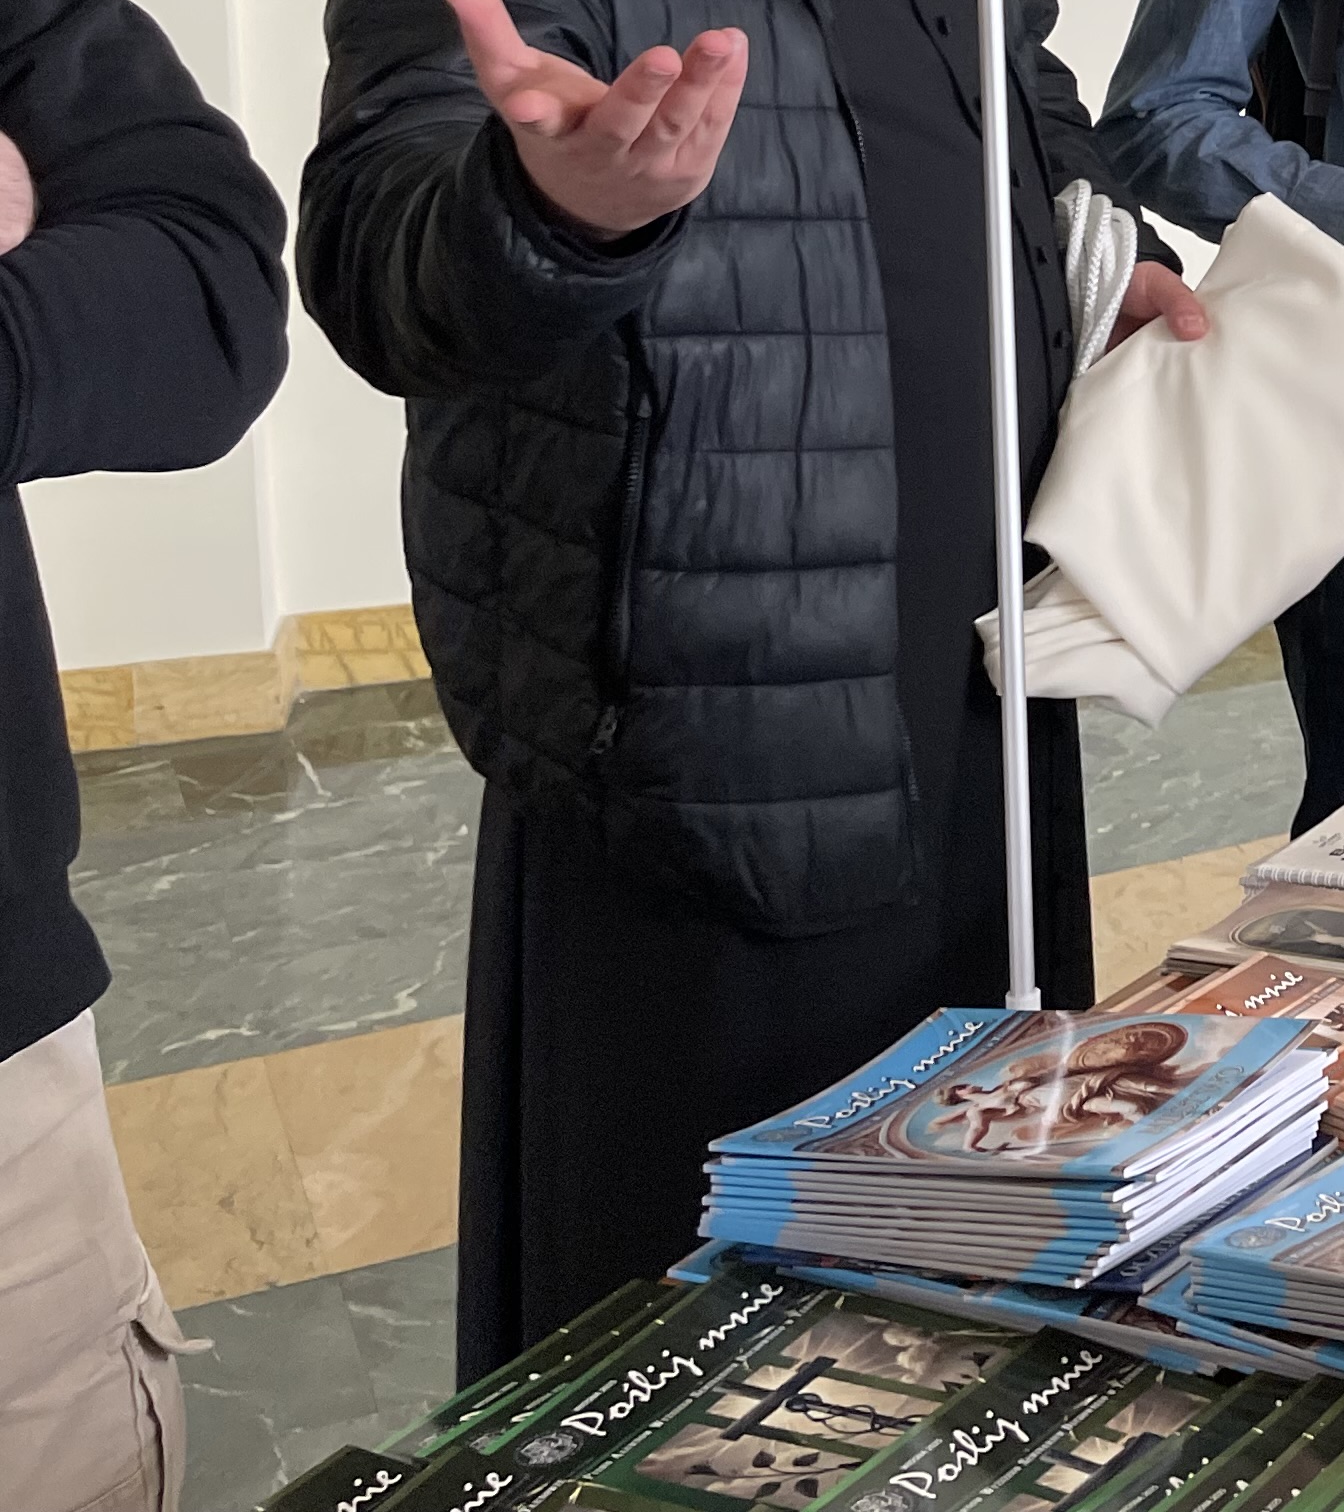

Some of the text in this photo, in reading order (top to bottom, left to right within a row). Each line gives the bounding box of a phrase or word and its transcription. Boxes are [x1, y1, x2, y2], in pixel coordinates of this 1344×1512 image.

[1244, 968, 1304, 1012] mnie
[795, 1020, 984, 1130] Poślij mnie
[561, 1349, 704, 1437] Poślij
[698, 1281, 783, 1353] mnie
[889, 1348, 1104, 1500] Poślij mnie
